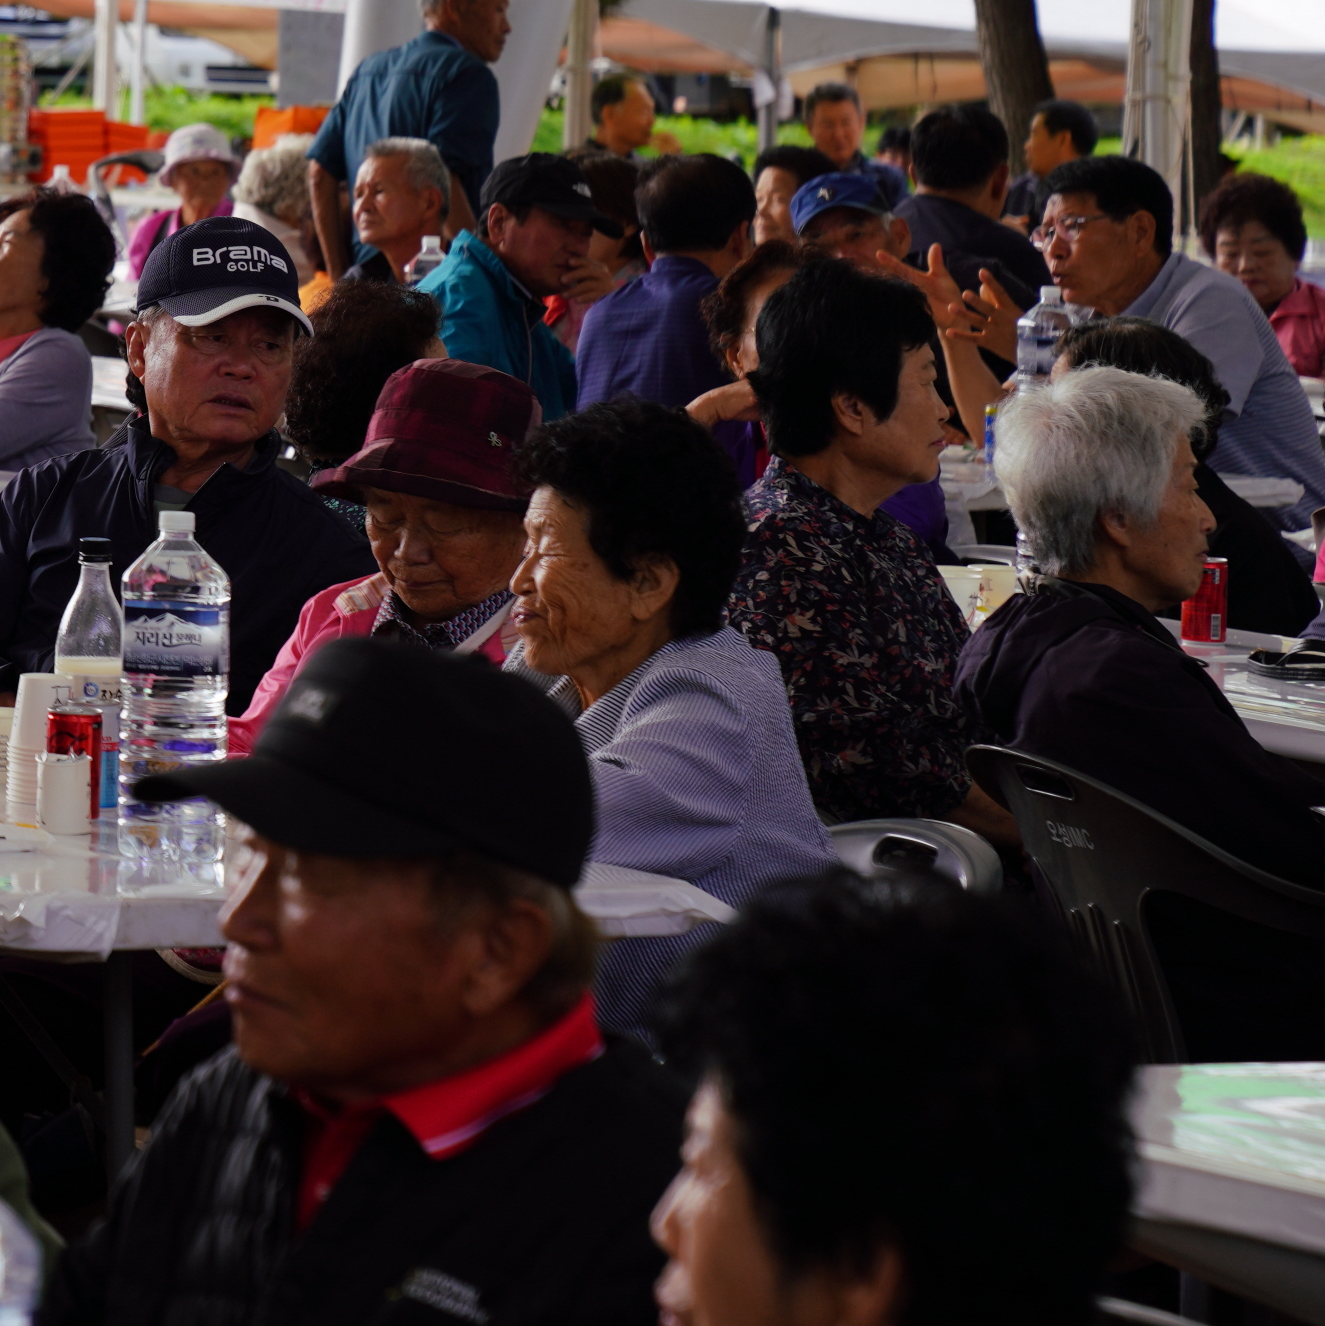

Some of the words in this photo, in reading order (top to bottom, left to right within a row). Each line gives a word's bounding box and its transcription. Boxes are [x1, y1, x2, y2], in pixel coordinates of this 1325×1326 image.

[192, 245, 289, 274] Brama
[227, 261, 265, 272] GOLF
[134, 631, 173, 647] 지리산
